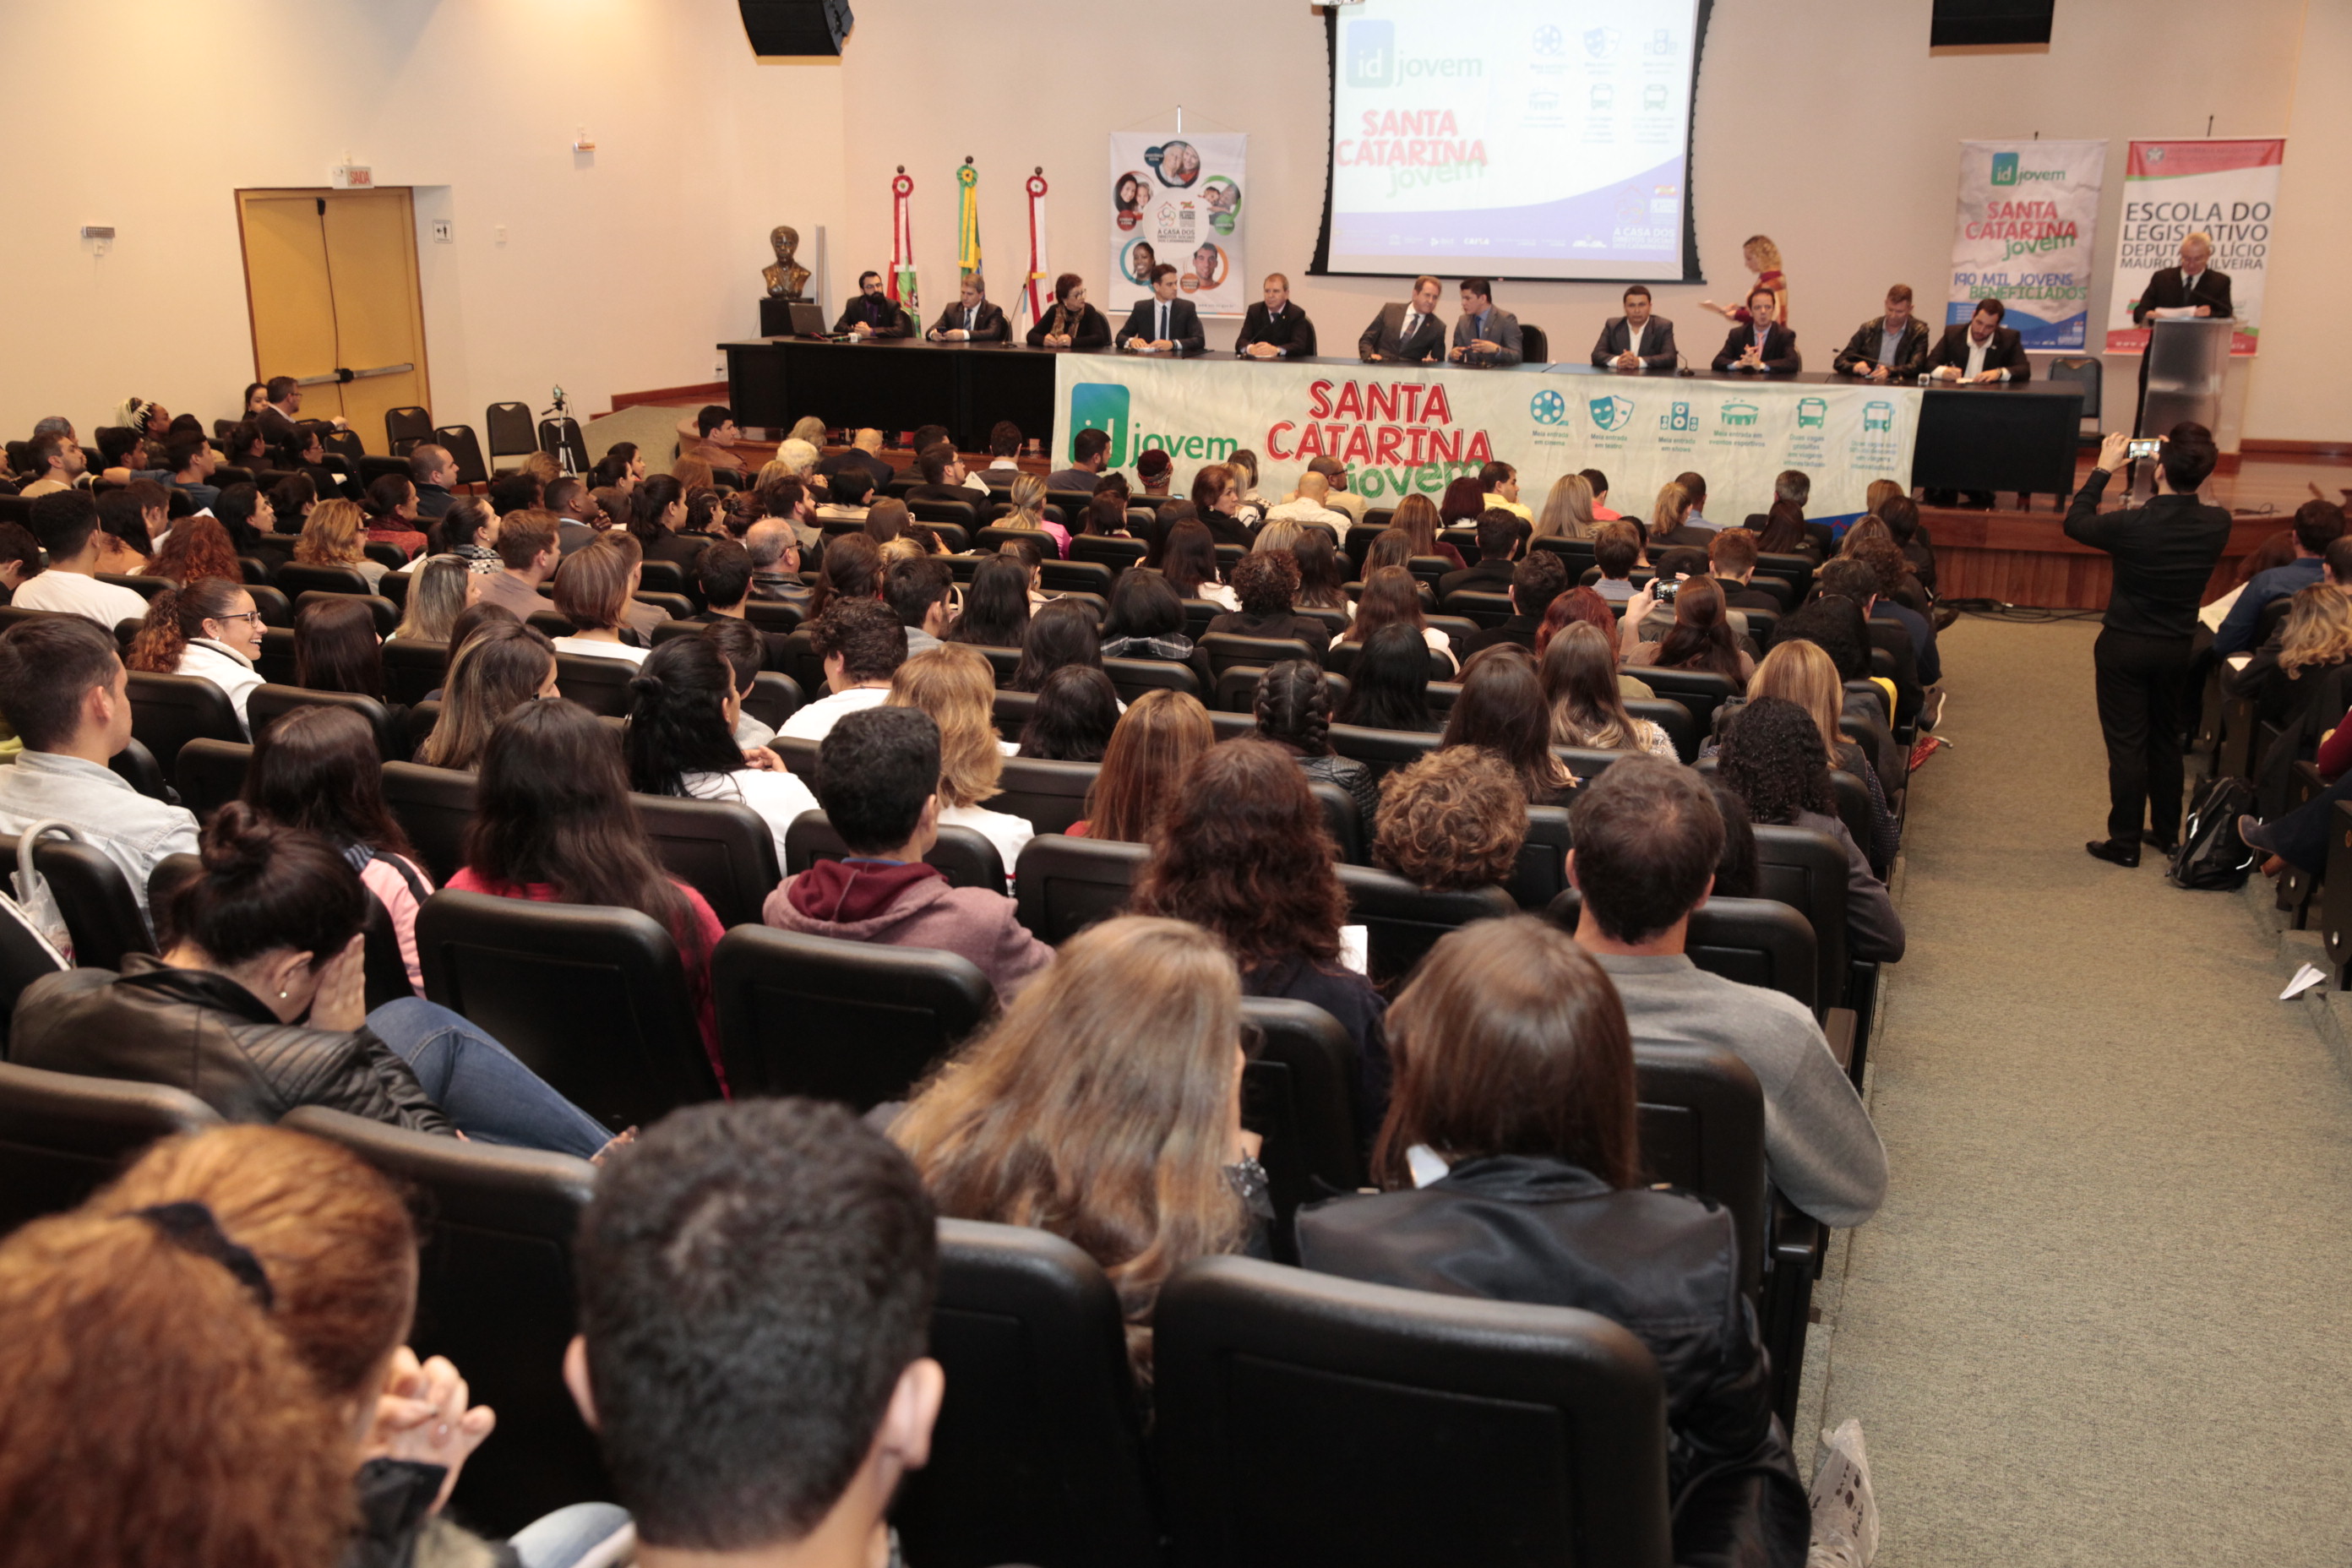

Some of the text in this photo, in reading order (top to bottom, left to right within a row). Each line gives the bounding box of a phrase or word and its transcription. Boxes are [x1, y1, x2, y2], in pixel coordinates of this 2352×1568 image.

[1358, 48, 1483, 87] id jovem
[1362, 109, 1458, 137] SANTA
[1336, 139, 1489, 167] CATARINA
[1386, 159, 1484, 199] jovem
[1997, 166, 2066, 185] id jovem
[1987, 201, 2058, 220] SANTA
[2125, 202, 2272, 222] ESCOLA DO
[1622, 226, 1652, 237] CASA
[1964, 221, 2078, 240] CATARINA
[2001, 235, 2076, 261] jovem
[2220, 240, 2267, 258] LÍCIO
[2120, 258, 2174, 270] MAURO
[2209, 259, 2263, 270] ILVEIRA
[1953, 273, 2075, 286] 190 MIL JOVENS
[1969, 286, 2088, 300] BENEFICIADOS
[1307, 379, 1452, 427] SANTA
[1129, 422, 1239, 468] jovem
[1265, 420, 1494, 469] CATARINA
